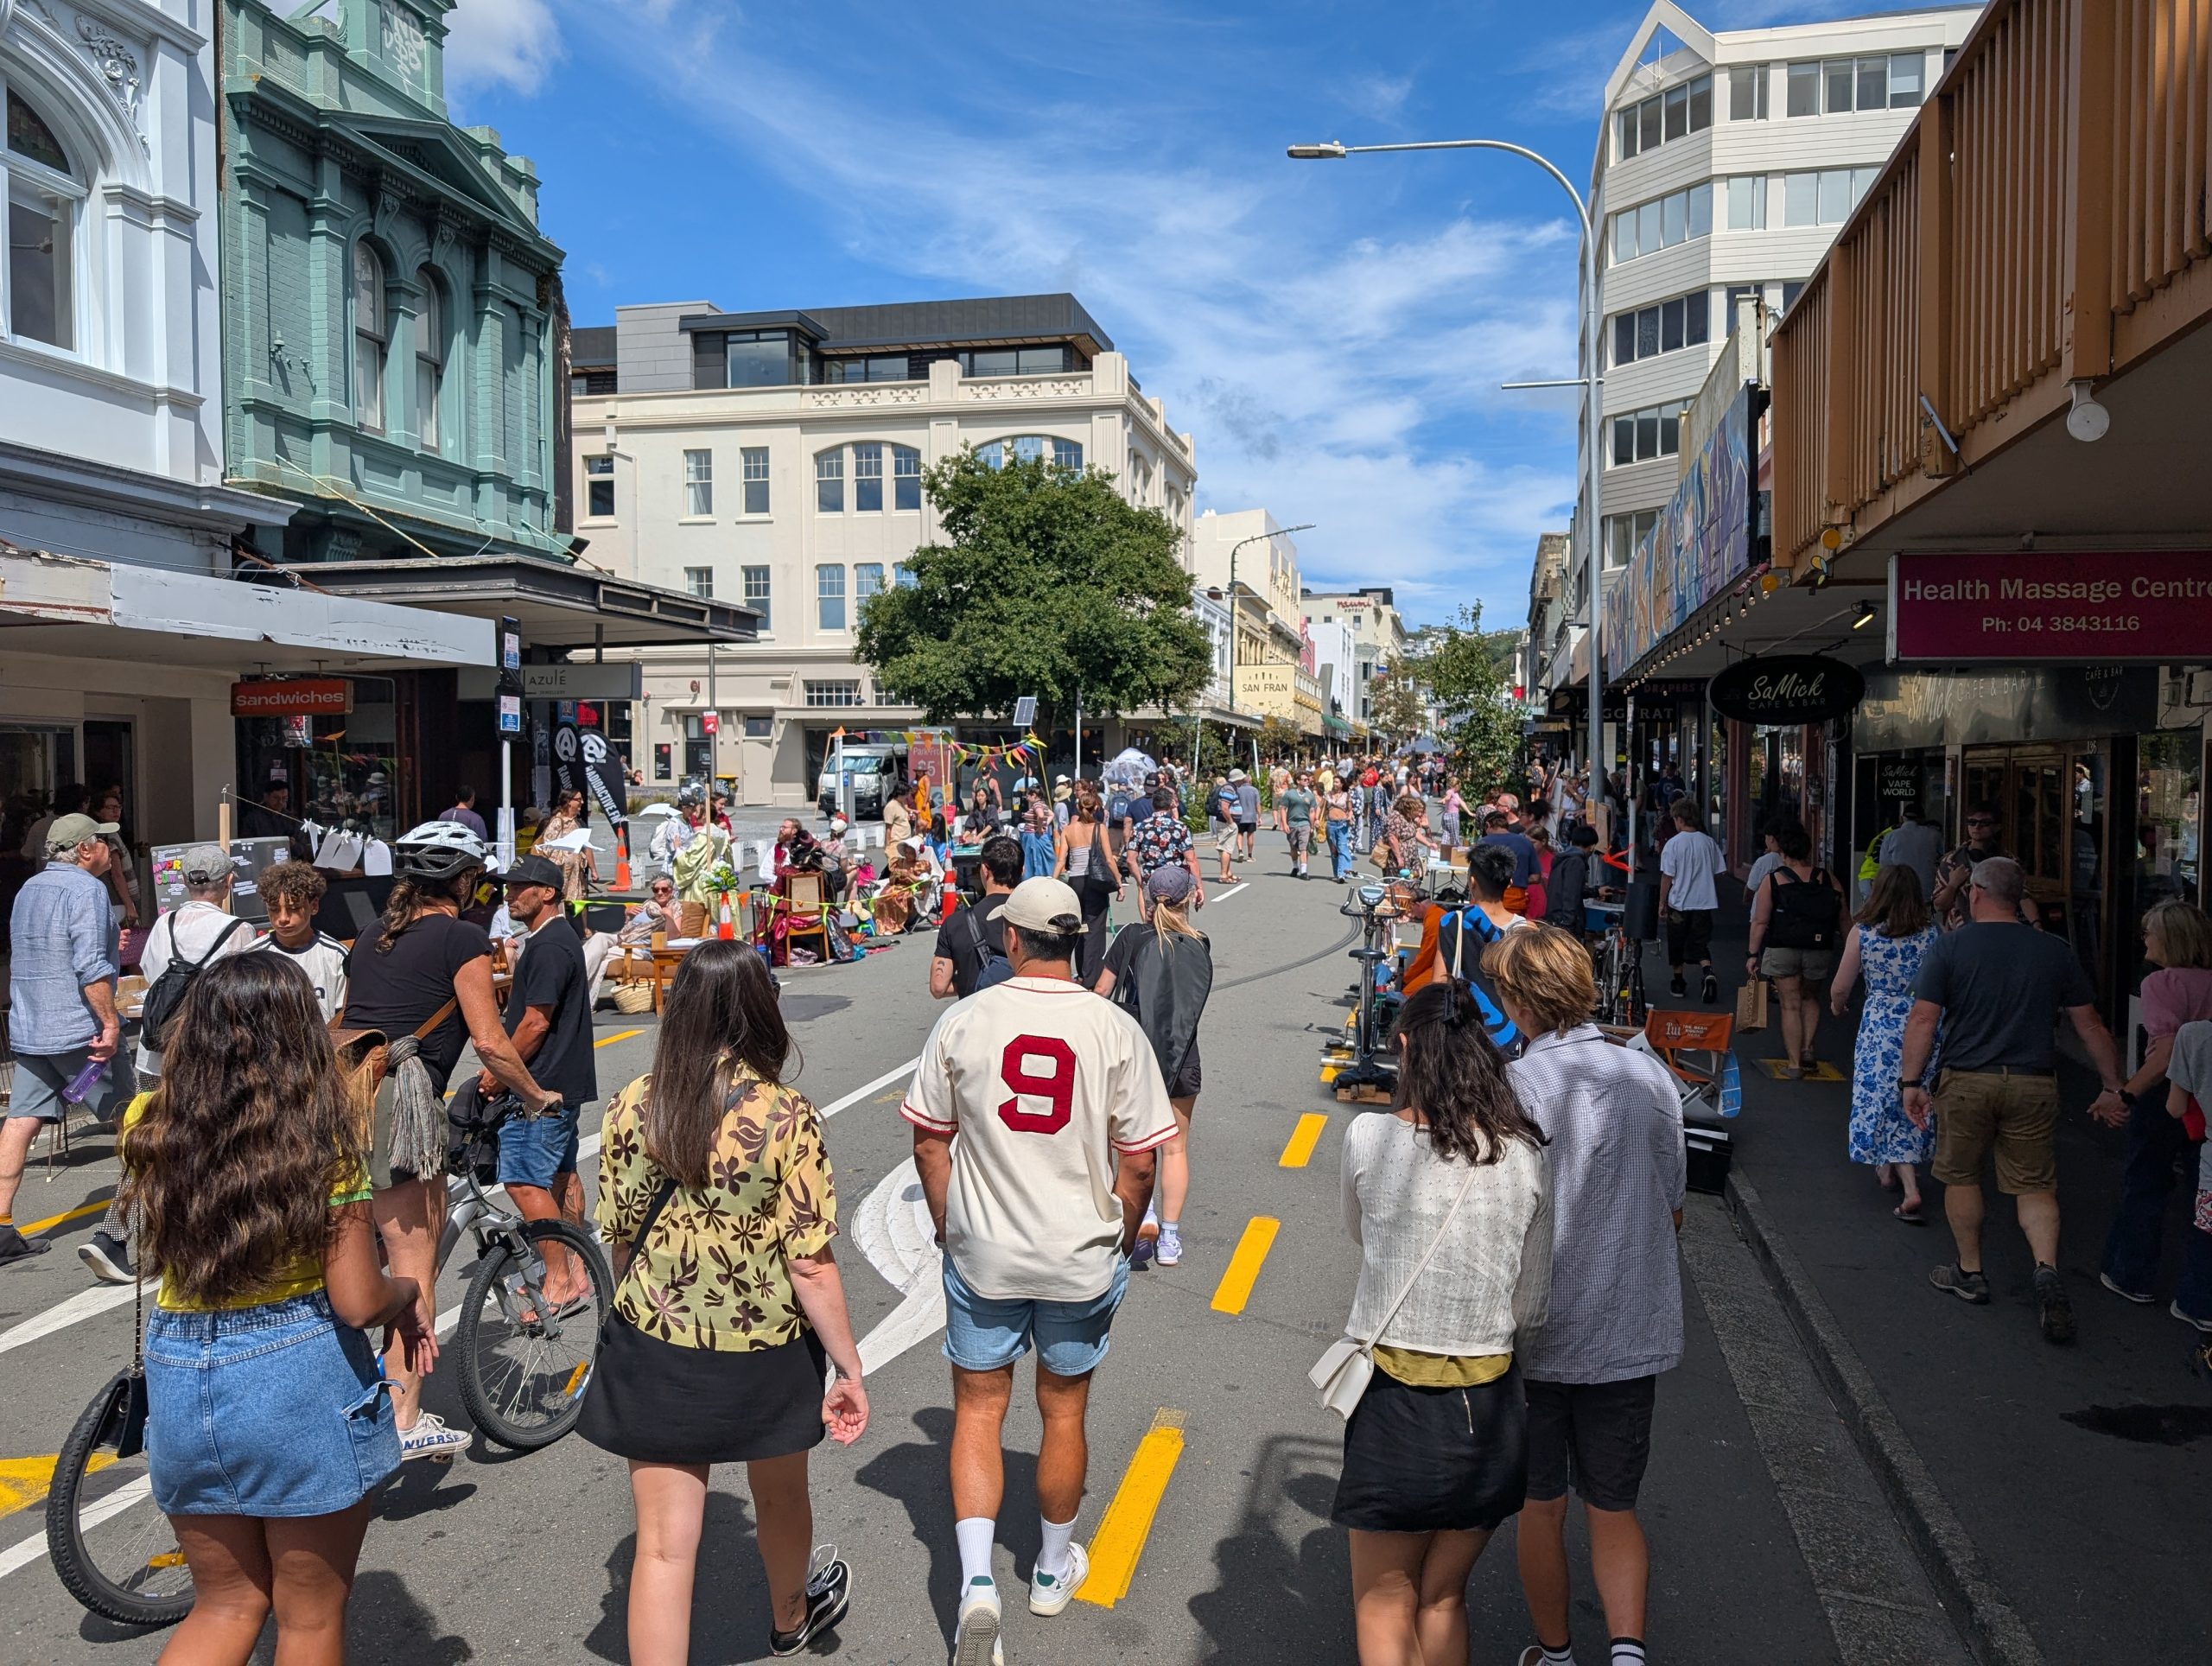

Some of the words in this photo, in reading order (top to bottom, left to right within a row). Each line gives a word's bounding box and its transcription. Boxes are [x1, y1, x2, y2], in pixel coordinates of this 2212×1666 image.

[1904, 579, 1990, 601] Health
[2000, 577, 2122, 602] Massage
[1982, 617, 2012, 633] Ph:
[2018, 616, 2043, 633] 04
[2049, 616, 2140, 632] 3843116
[1242, 684, 1259, 692] SAN
[1264, 683, 1287, 692] FRAN
[1748, 672, 1825, 701] SaMick
[236, 691, 344, 706] Sandwiches
[1748, 700, 1781, 710] CAFE
[1788, 699, 1796, 708] &
[1802, 697, 1826, 707] BAR
[1907, 666, 1957, 726] SaMick
[1956, 677, 1985, 702] CAFE
[1990, 677, 1998, 696] &
[2004, 671, 2027, 694] BAR
[1582, 707, 1674, 720] ZGGRAT
[2087, 740, 2097, 754] 136
[1887, 779, 1912, 788] VAPE
[1665, 1021, 1681, 1035] Tui
[998, 1034, 1076, 1135] 9
[403, 1434, 460, 1450] NVERSE
